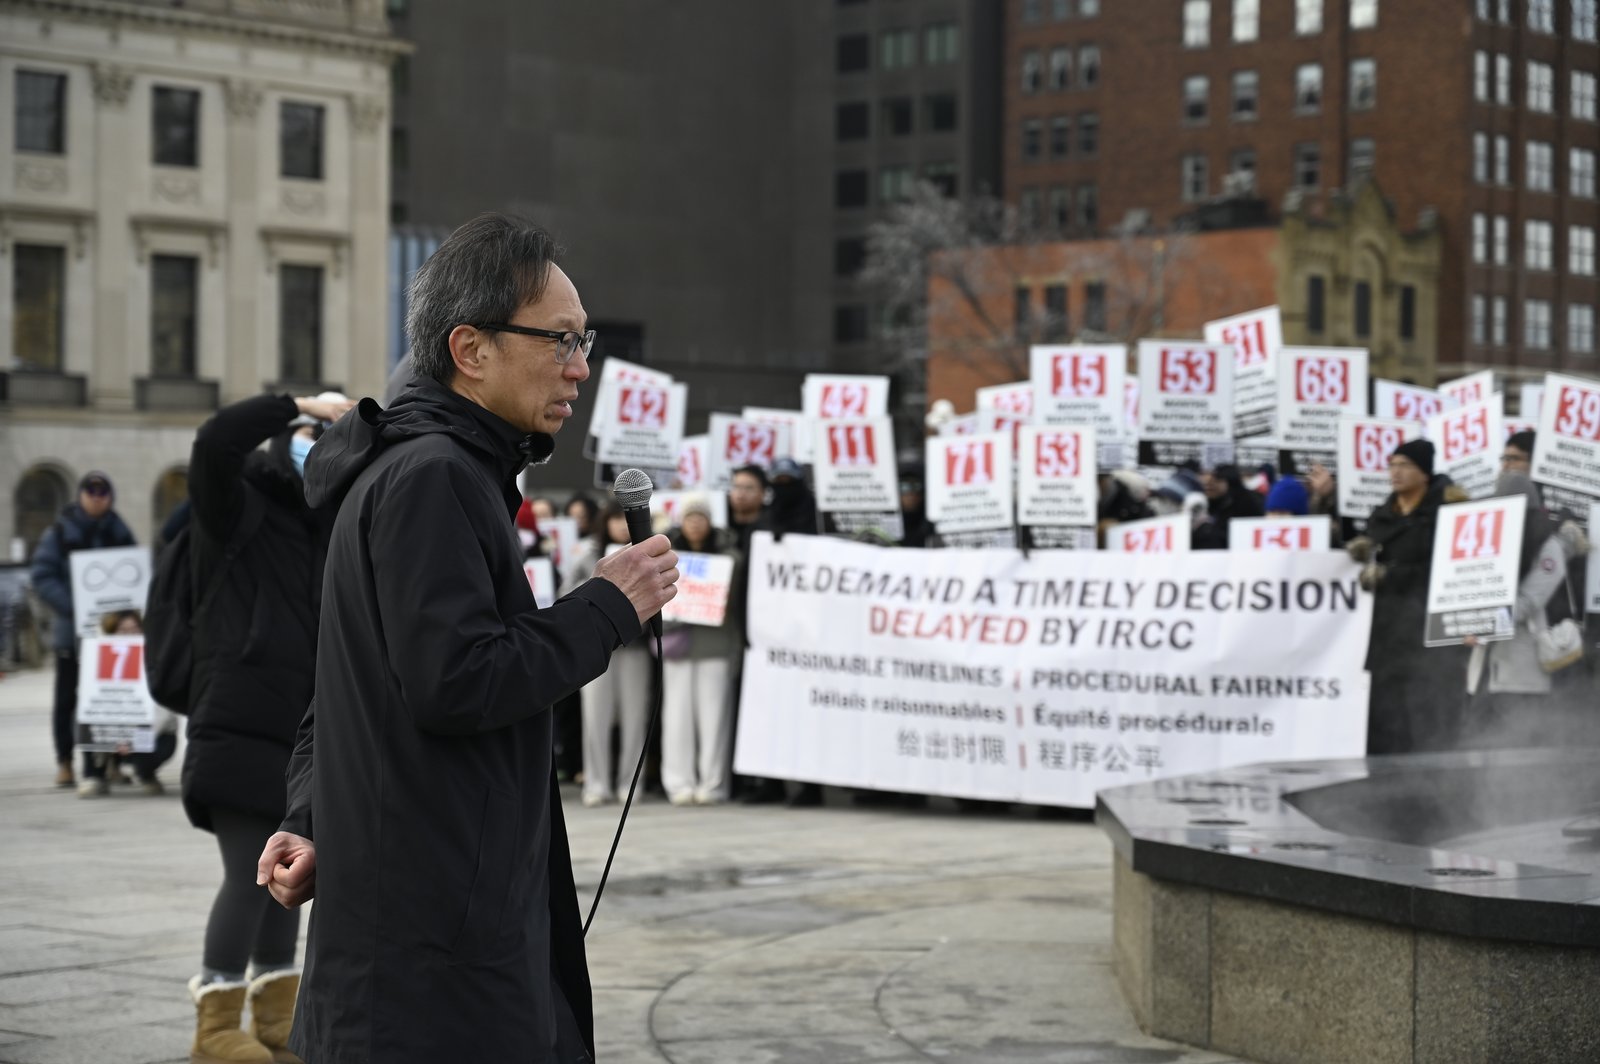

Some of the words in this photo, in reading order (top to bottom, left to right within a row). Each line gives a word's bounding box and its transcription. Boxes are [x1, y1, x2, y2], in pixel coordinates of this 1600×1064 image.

[1054, 355, 1103, 397] 15
[1162, 350, 1213, 393] 53
[1299, 358, 1346, 403] 68
[620, 387, 666, 429] 42
[1557, 386, 1600, 441] 39
[726, 423, 775, 466] 32
[1037, 432, 1079, 478] 53
[1445, 408, 1485, 459] 55
[947, 440, 992, 486] 71
[1454, 510, 1501, 560] 41
[814, 565, 964, 605] DEMAND
[975, 578, 997, 605] A
[1014, 579, 1145, 610] TIMELY
[1155, 579, 1358, 612] DECISION
[869, 606, 1028, 645] DELAYED
[1040, 618, 1088, 646] BY
[1096, 619, 1195, 650] IRCC
[767, 648, 884, 679] REASONABLE
[892, 658, 1002, 688] TIMELINES
[1032, 669, 1201, 696] PROCEDURAL
[1211, 676, 1341, 700] FAIRNESS
[872, 697, 1006, 724] raisonnables
[1034, 702, 1109, 729] Équité
[1118, 713, 1275, 737] procédurale
[1039, 740, 1164, 775] 程序公平
